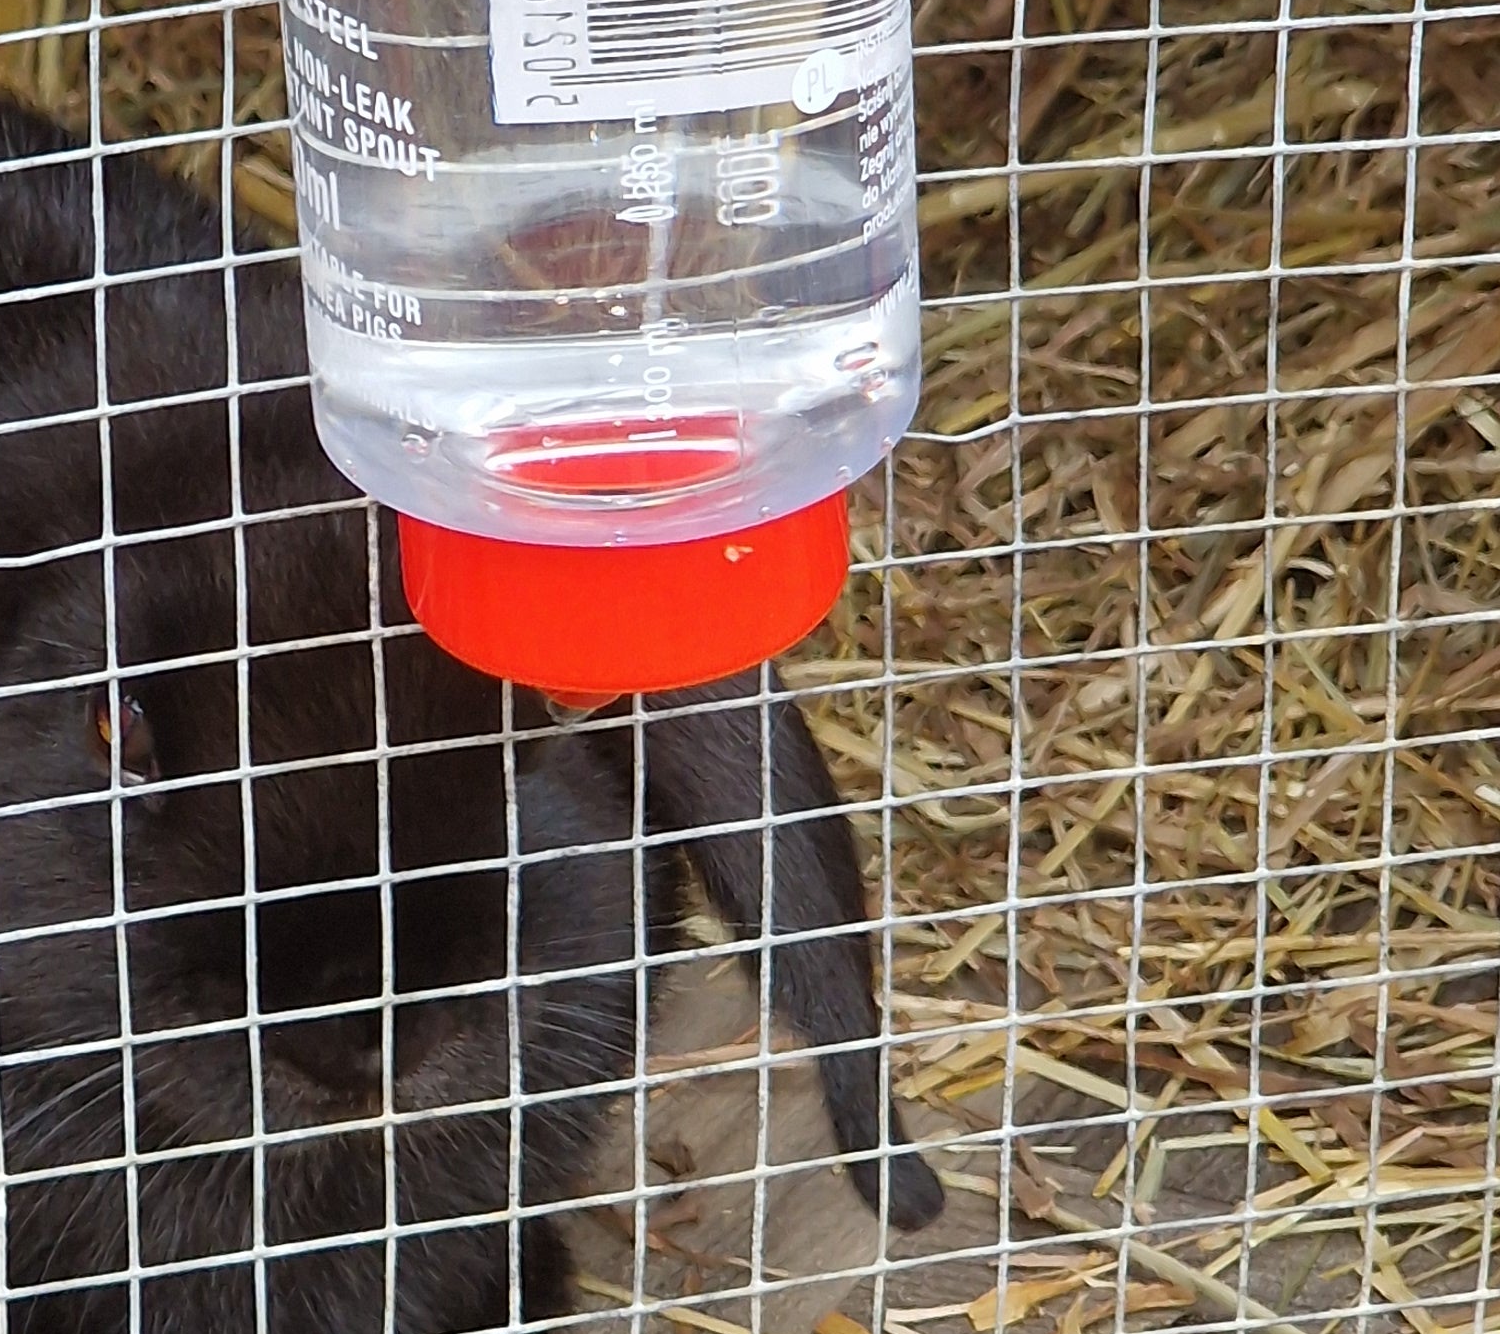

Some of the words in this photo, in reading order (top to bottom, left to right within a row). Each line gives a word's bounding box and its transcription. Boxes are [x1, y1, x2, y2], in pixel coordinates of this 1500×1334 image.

[806, 62, 834, 103] PL
[342, 117, 442, 183] SPOUT
[858, 122, 879, 153] nie
[862, 185, 879, 209] do
[373, 280, 422, 327] FOR
